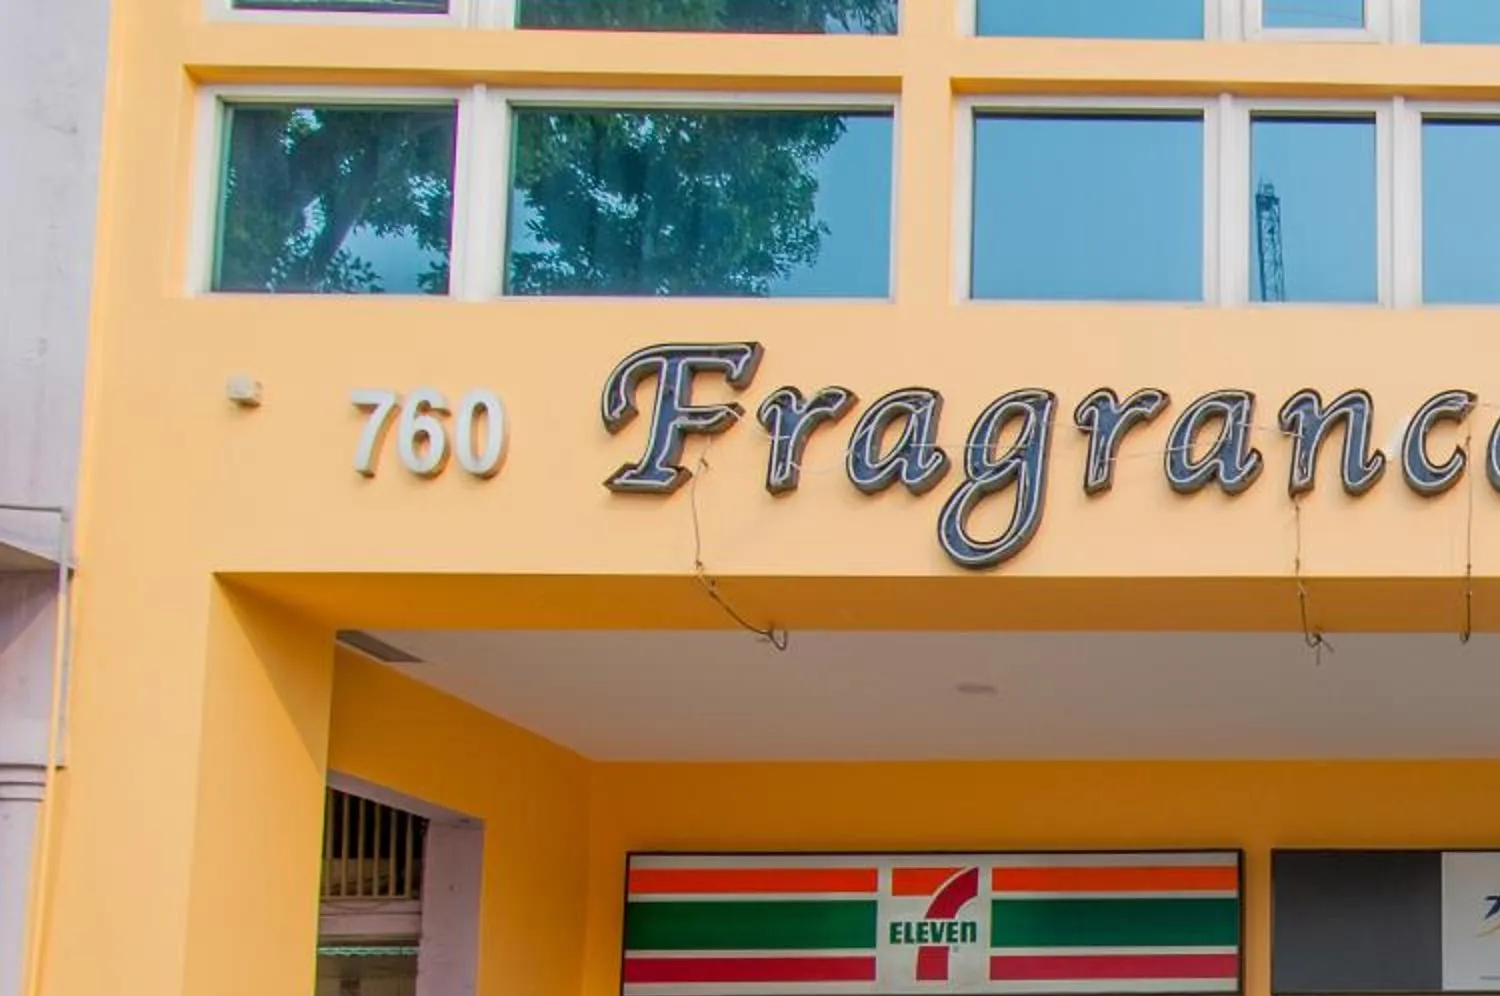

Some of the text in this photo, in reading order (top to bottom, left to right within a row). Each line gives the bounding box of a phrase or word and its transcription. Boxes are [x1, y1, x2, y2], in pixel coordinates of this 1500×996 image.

[350, 388, 508, 478] 760
[889, 921, 977, 944] ELEVEN
[891, 867, 979, 981] 7
